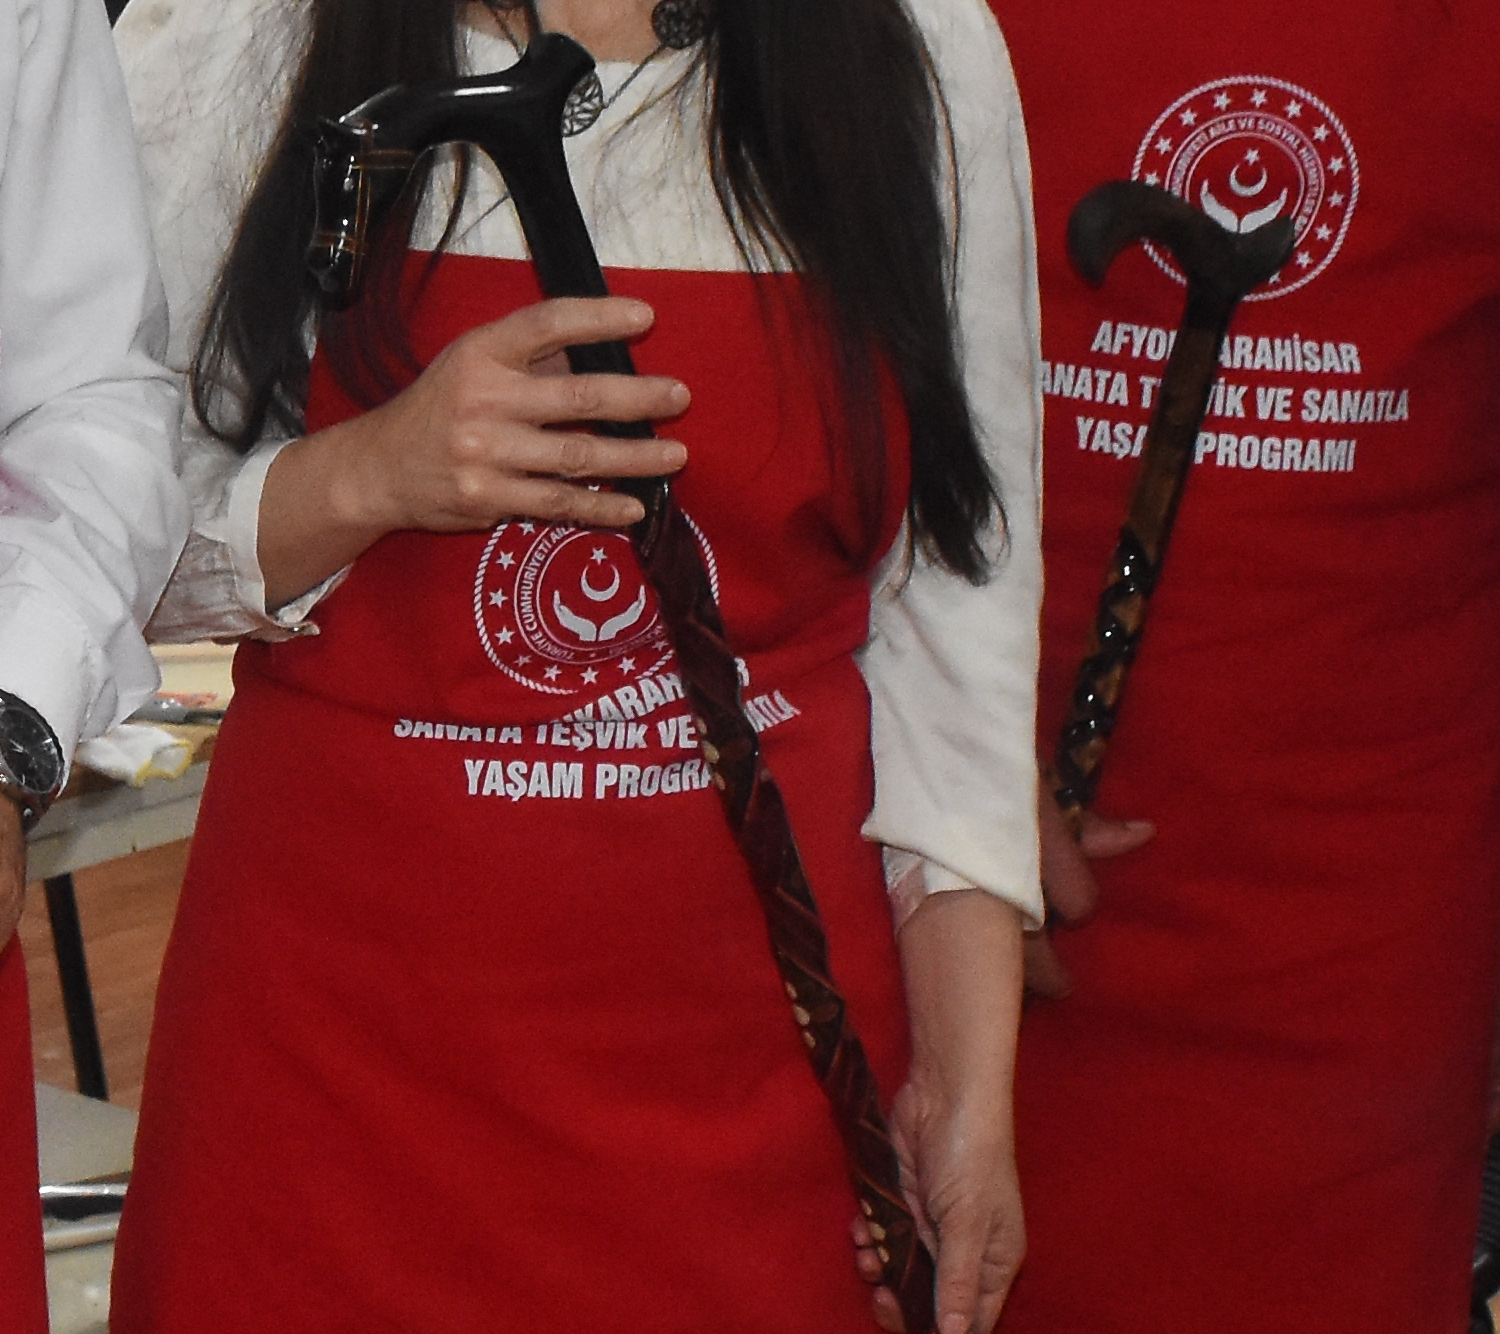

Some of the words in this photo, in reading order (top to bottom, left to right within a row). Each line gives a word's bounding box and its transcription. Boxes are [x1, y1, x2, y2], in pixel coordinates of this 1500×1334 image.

[1041, 360, 1129, 407] ANATA
[1256, 385, 1294, 422] VE
[1301, 388, 1409, 424] SANATLA
[1194, 431, 1357, 473] PROGRAMI
[657, 715, 697, 748] VE
[464, 759, 583, 801] YAŞAM
